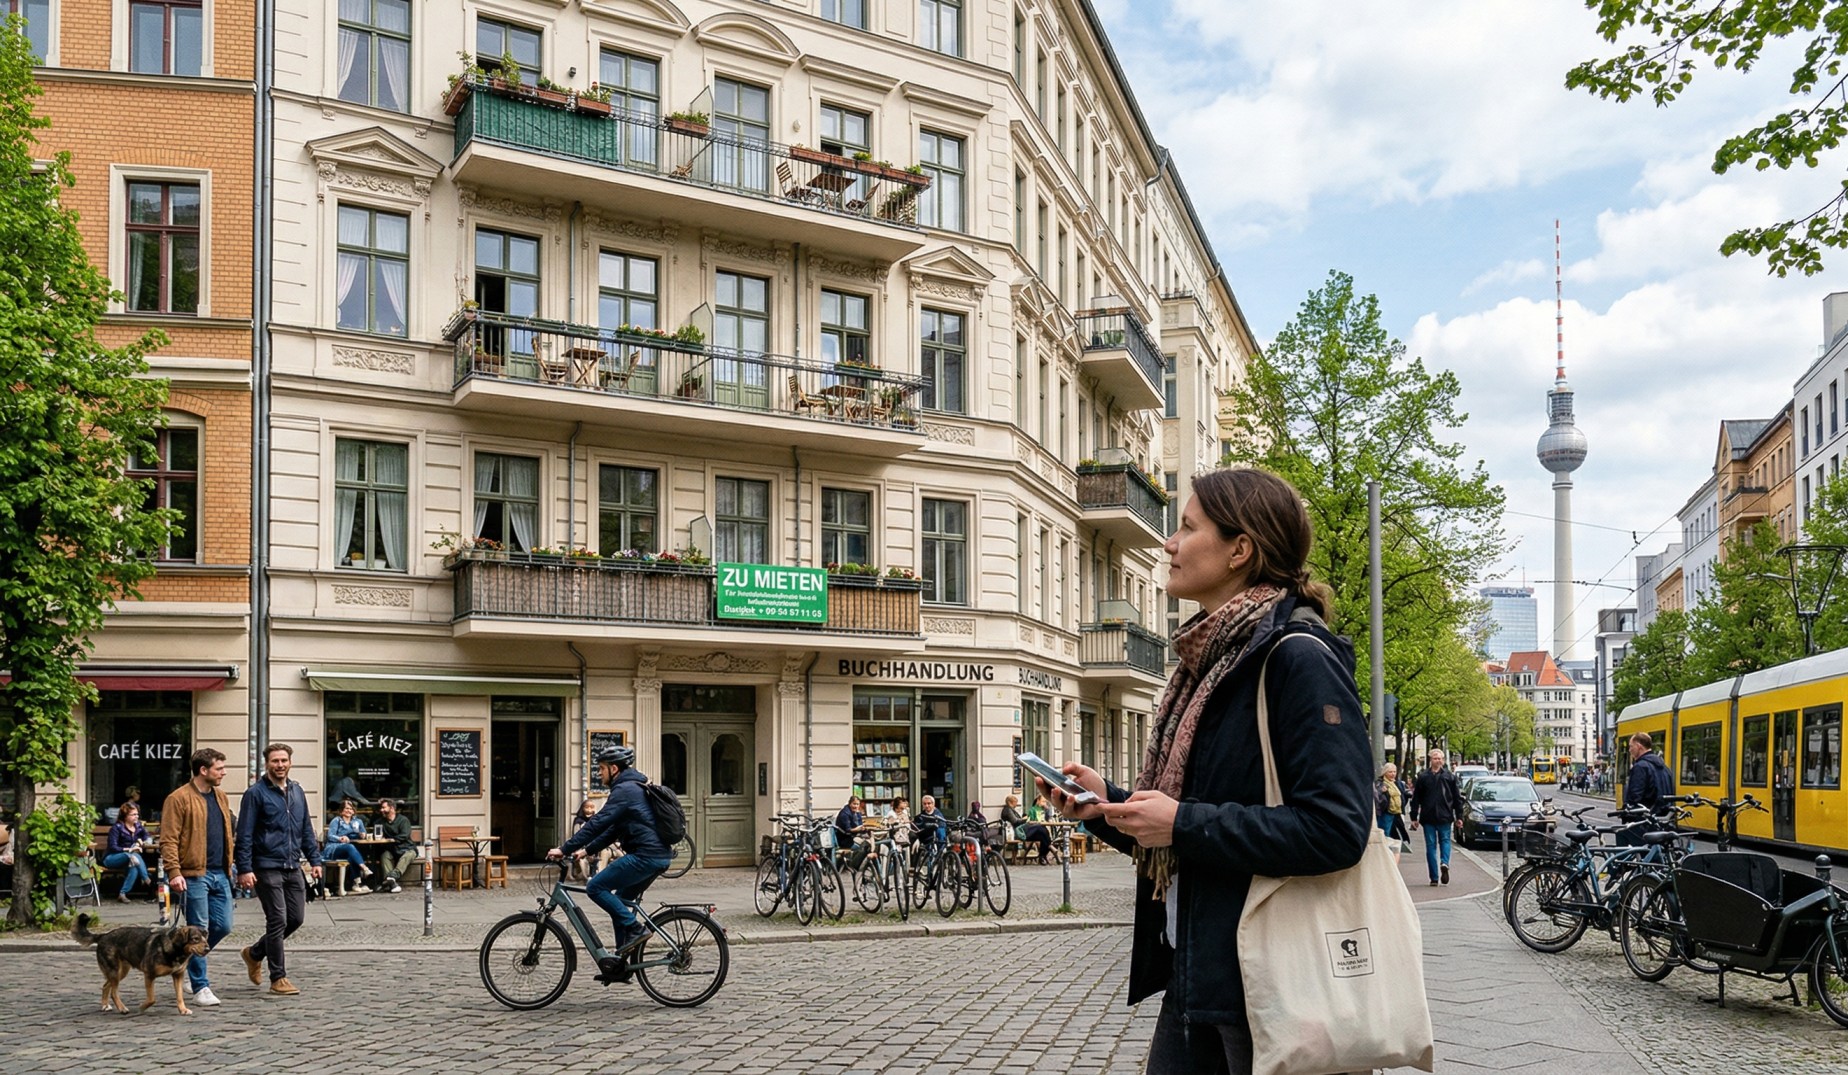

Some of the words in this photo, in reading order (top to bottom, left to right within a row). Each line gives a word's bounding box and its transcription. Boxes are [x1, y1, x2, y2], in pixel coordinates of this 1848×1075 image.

[723, 568, 748, 587] ZU
[755, 570, 823, 592] MIETEN
[801, 609, 810, 617] 11
[838, 659, 994, 681] BUCHHANDLUNG
[98, 740, 140, 759] CAFÉ
[145, 744, 182, 759] KIEZ
[337, 731, 374, 754] CAFÉ
[379, 734, 412, 756] KIEZ
